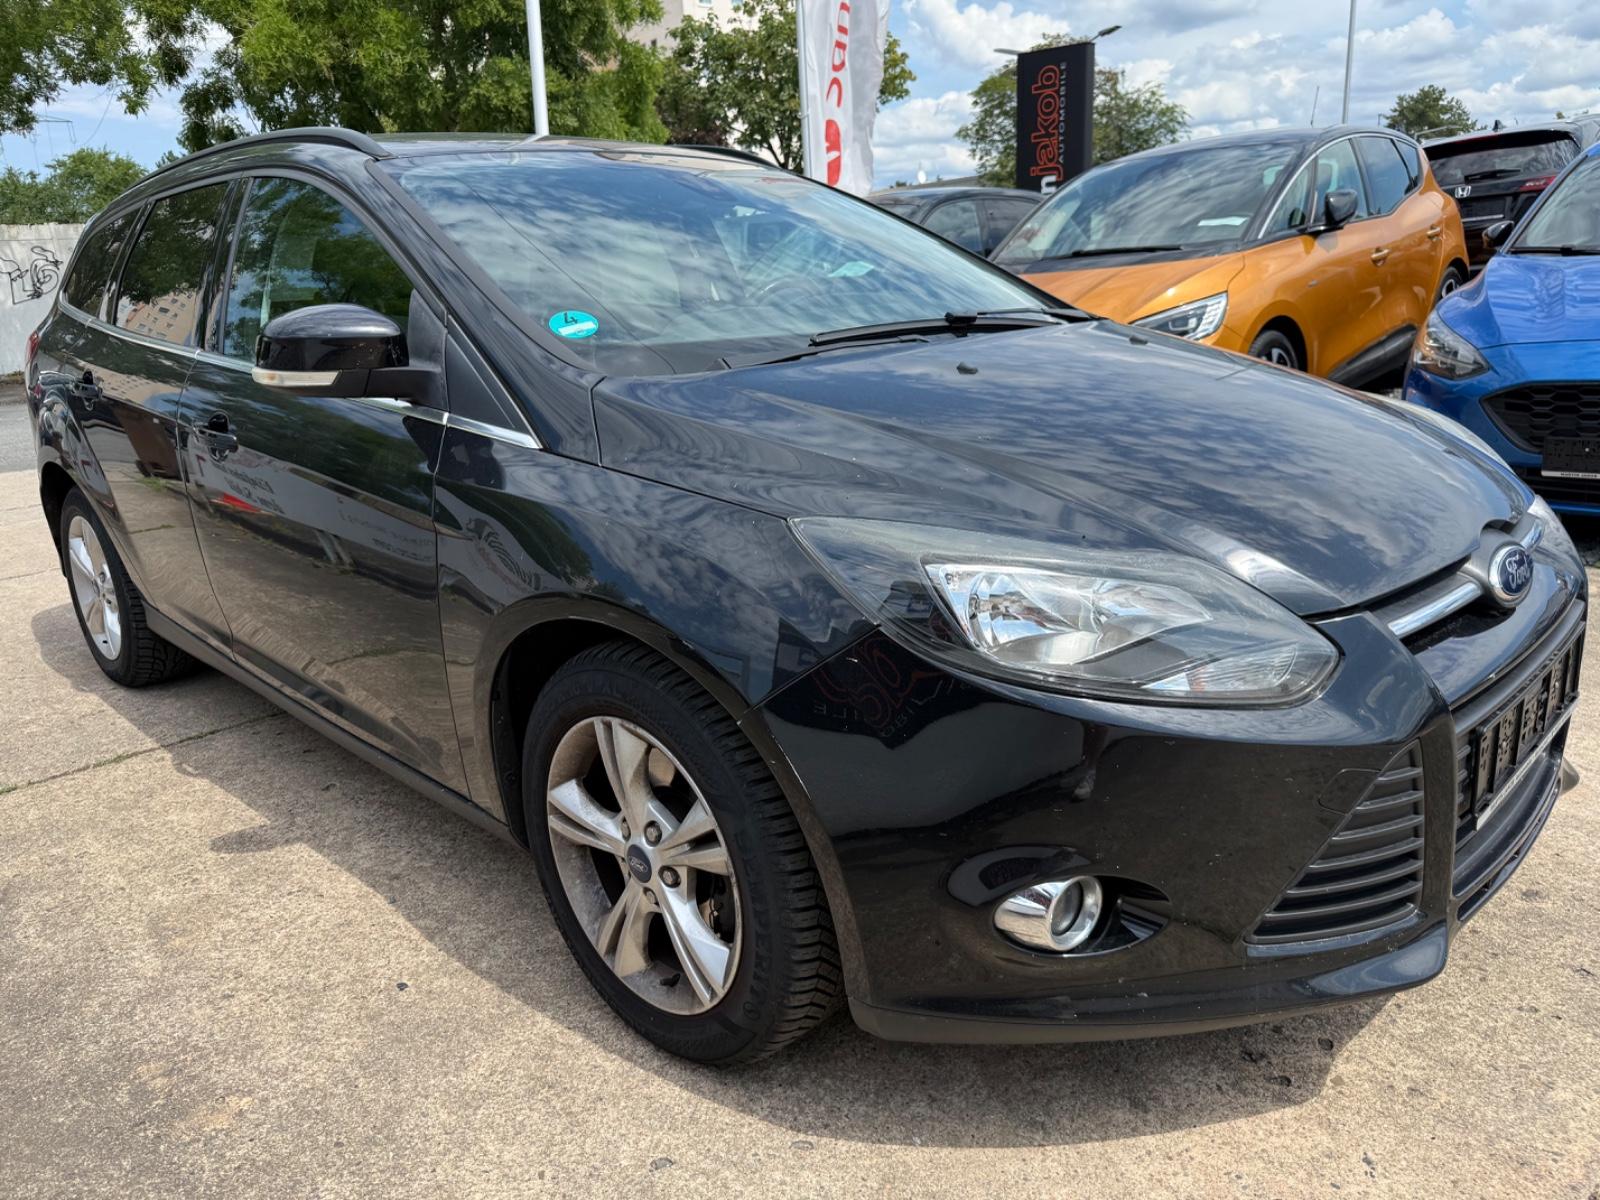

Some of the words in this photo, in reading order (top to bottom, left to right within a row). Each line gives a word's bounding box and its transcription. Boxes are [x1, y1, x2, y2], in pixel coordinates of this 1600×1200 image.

[1058, 61, 1067, 164] AUTOMOBILE
[563, 312, 578, 324] 4
[1505, 552, 1531, 590] Ford
